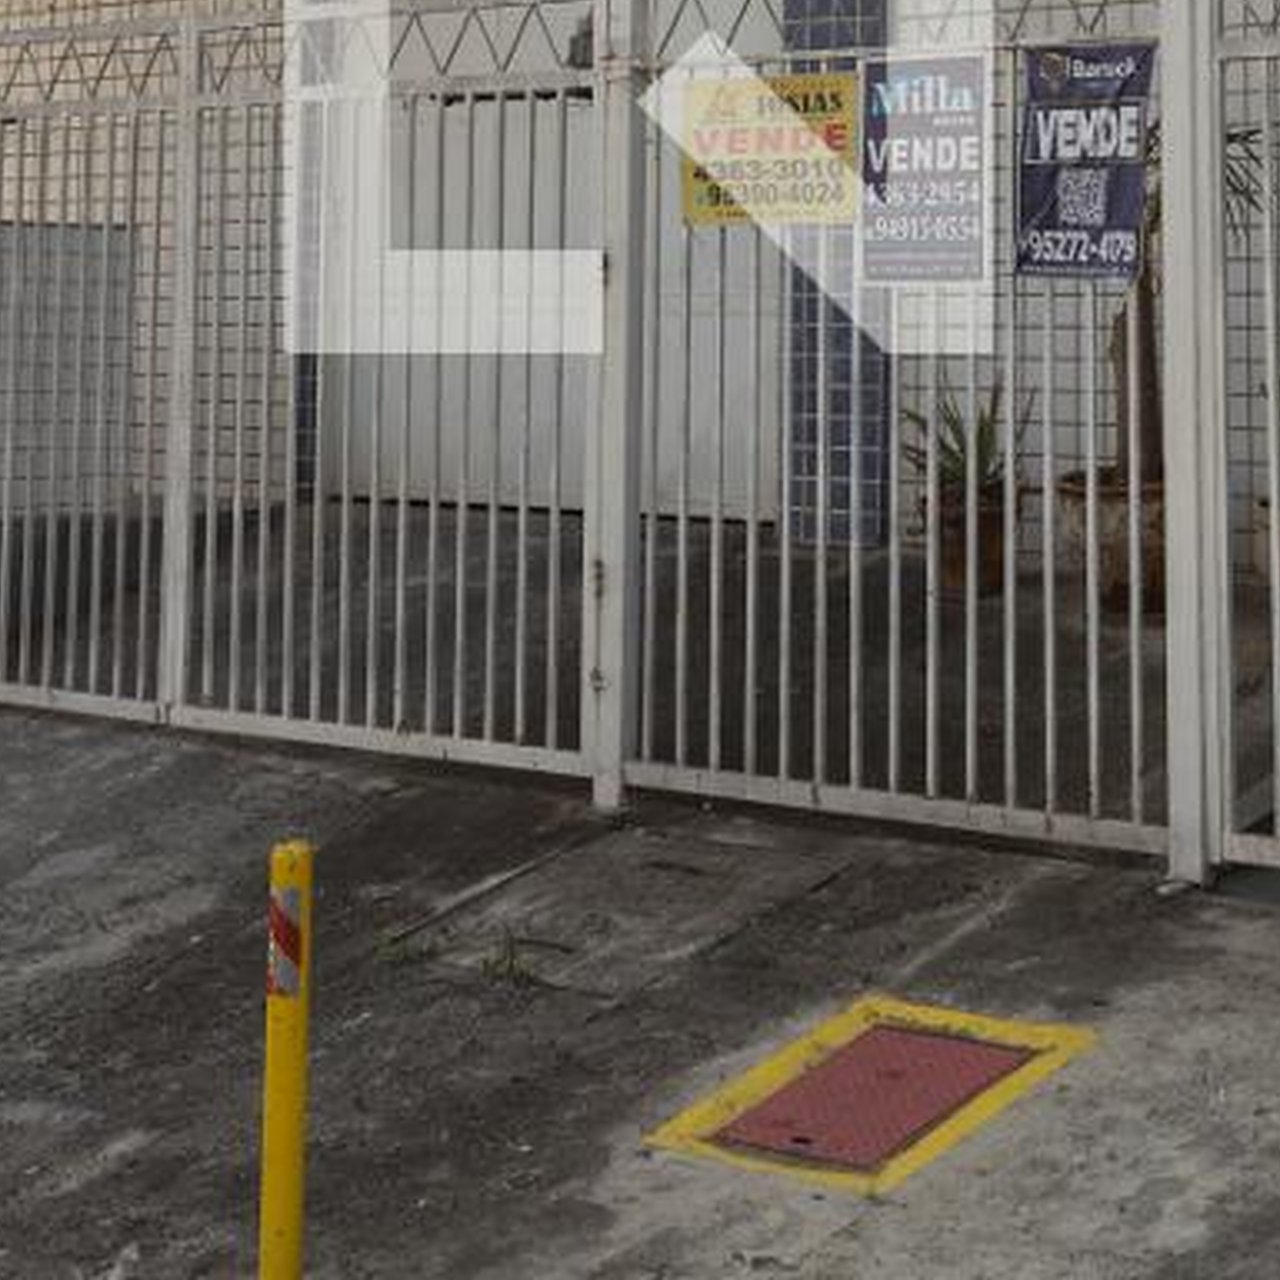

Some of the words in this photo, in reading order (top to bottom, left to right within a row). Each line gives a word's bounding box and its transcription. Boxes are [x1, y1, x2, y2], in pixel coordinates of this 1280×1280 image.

[693, 123, 848, 154] VENDE
[1037, 106, 1138, 158] VENDE
[867, 135, 980, 172] VENDE
